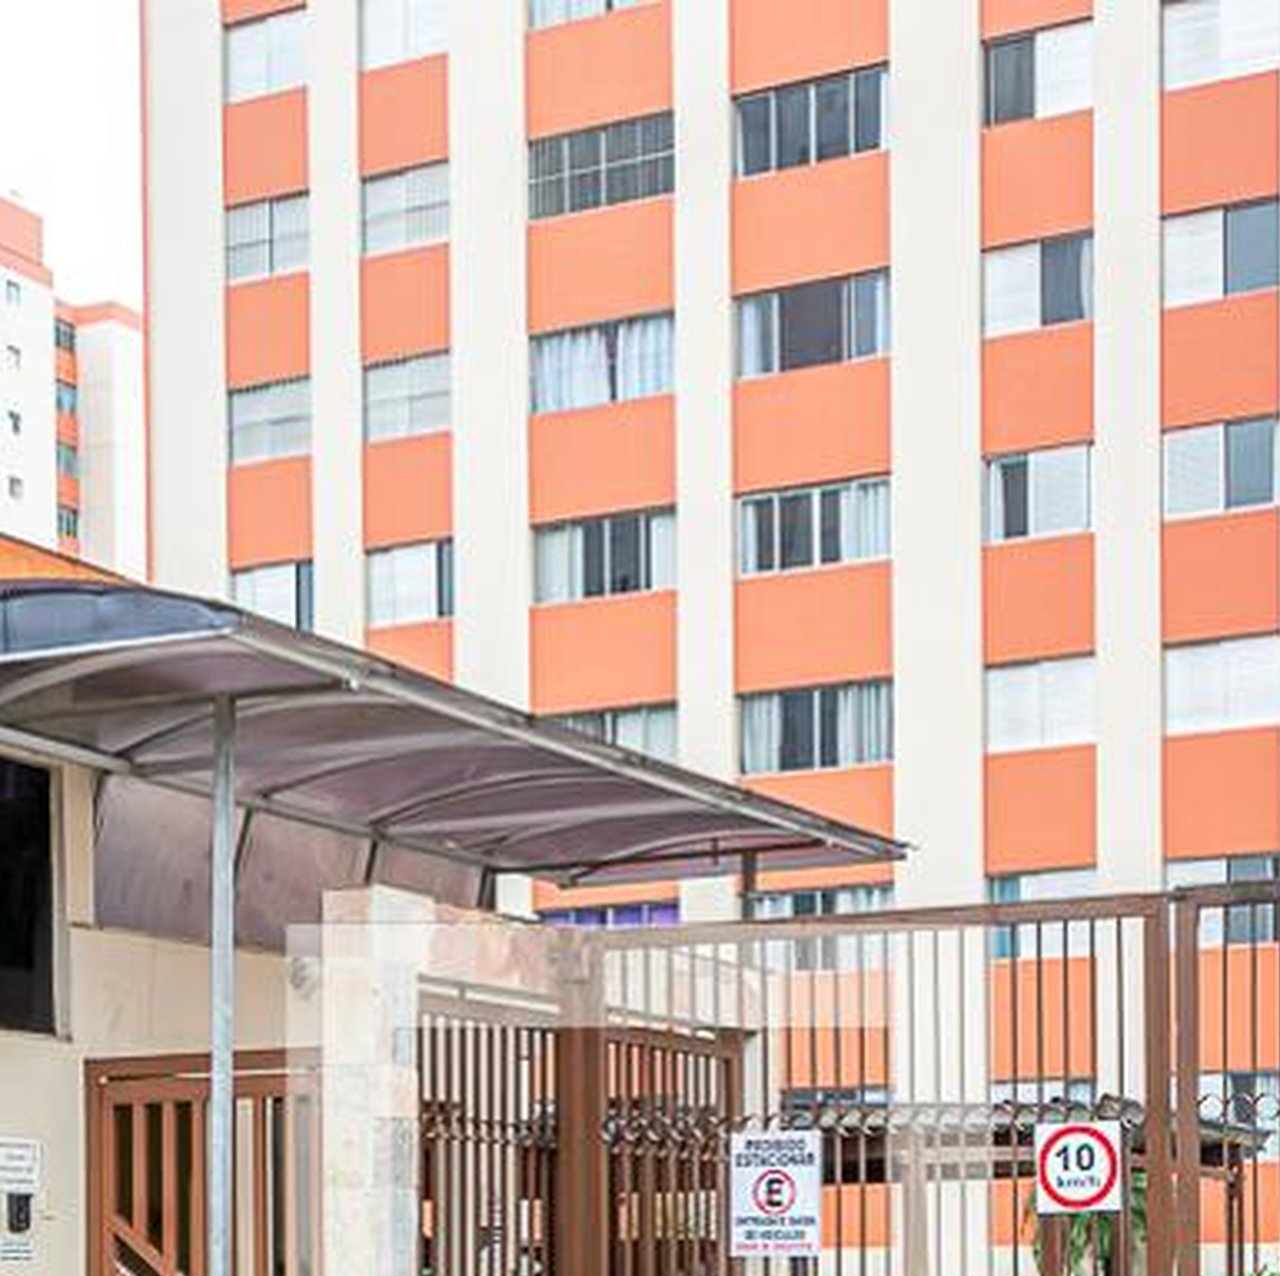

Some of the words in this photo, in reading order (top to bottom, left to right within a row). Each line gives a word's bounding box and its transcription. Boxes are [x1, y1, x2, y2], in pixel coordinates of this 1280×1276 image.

[745, 1139, 806, 1151] PROIBIDO
[736, 1152, 815, 1167] ESTACIONAR
[1055, 1143, 1095, 1171] 10
[766, 1178, 785, 1207] E
